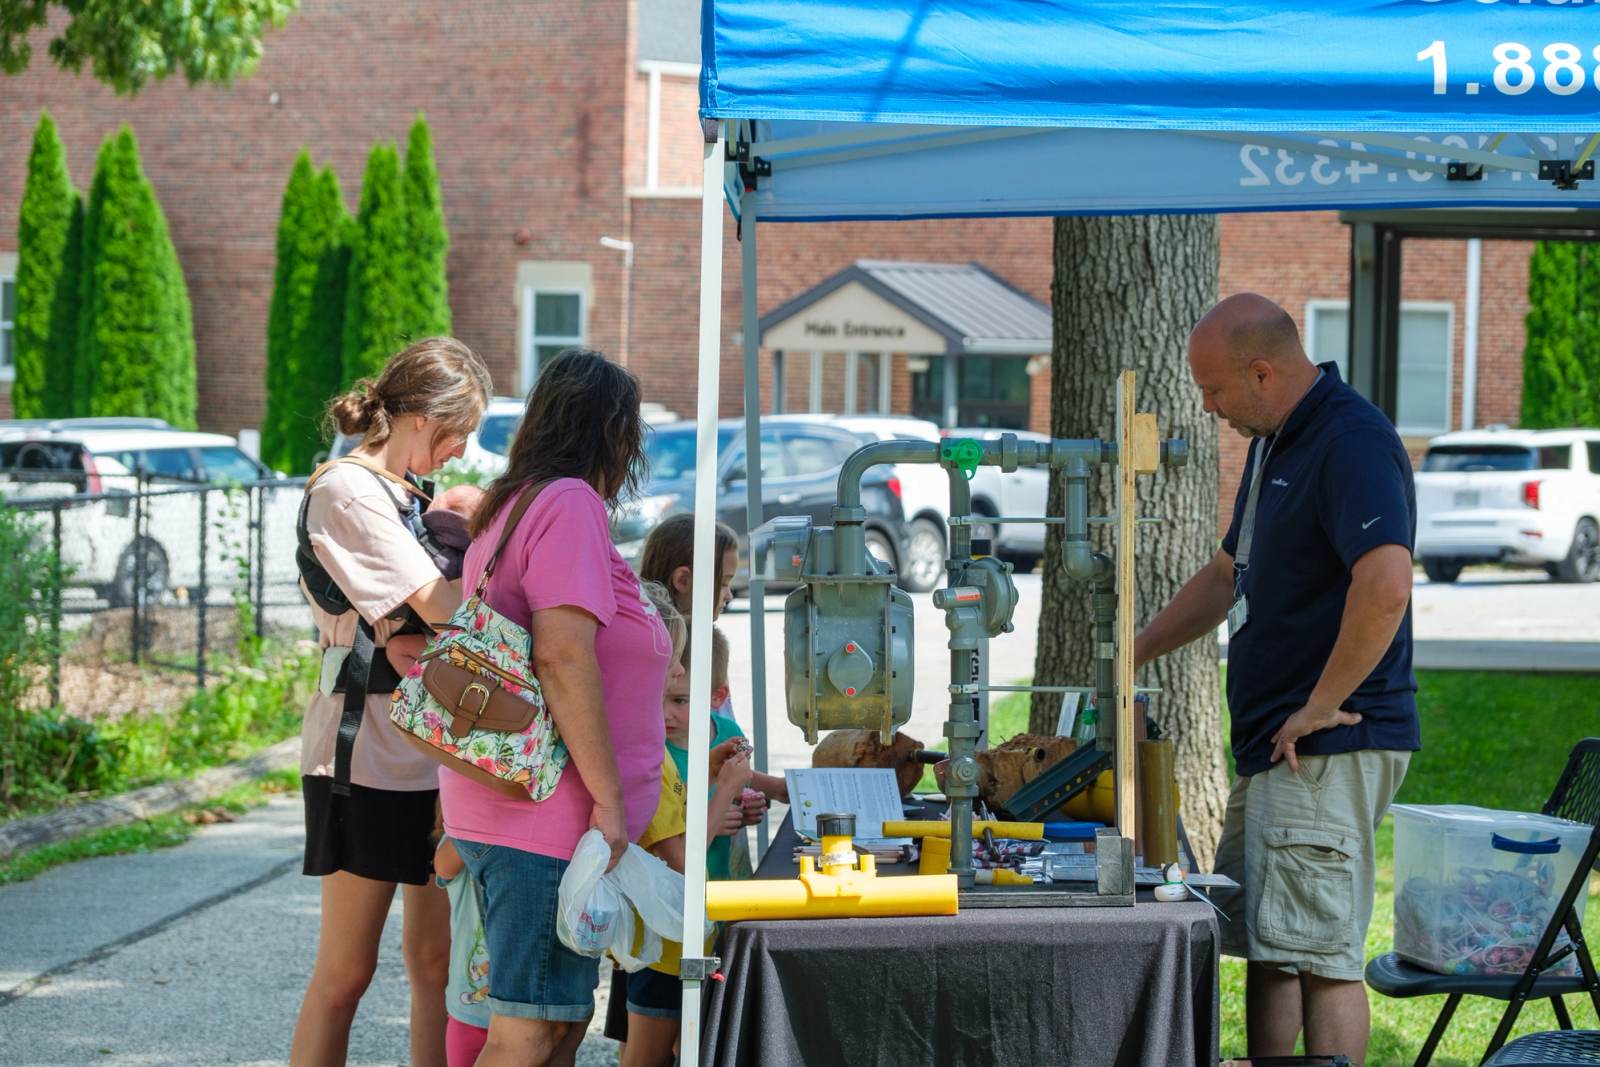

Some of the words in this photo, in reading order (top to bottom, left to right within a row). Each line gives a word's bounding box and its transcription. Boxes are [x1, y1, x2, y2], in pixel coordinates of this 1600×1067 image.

[1416, 40, 1600, 96] 1.88
[805, 321, 837, 337] Main
[844, 320, 905, 338] Entrance
